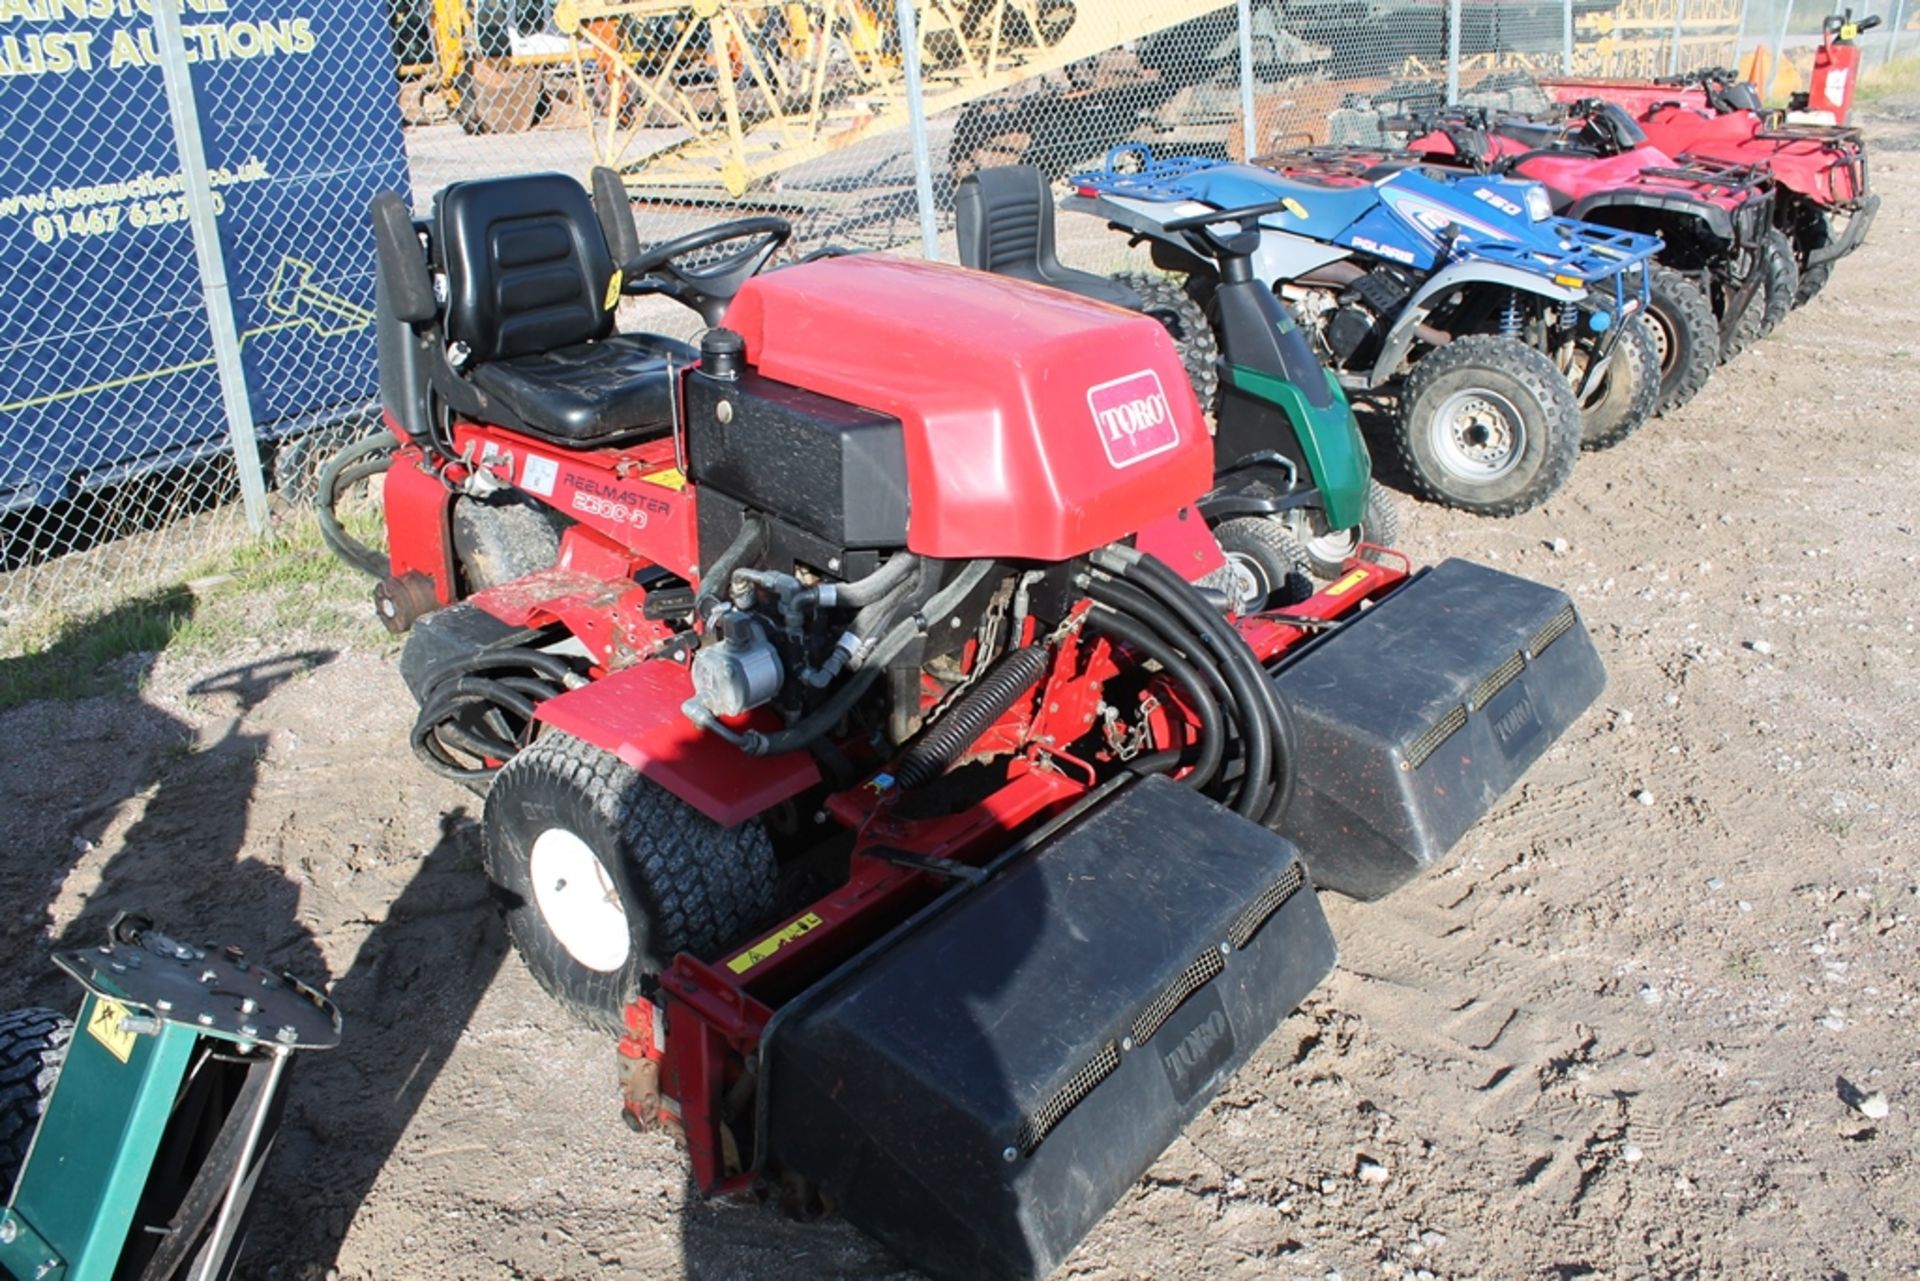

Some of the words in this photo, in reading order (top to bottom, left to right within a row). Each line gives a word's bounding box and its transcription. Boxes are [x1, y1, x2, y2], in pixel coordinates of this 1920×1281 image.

[32, 205, 121, 243] 01467
[128, 190, 226, 228] 62370
[1099, 393, 1165, 445] TORO
[563, 472, 671, 516] REELMASTER
[1164, 1010, 1226, 1081] TORO
